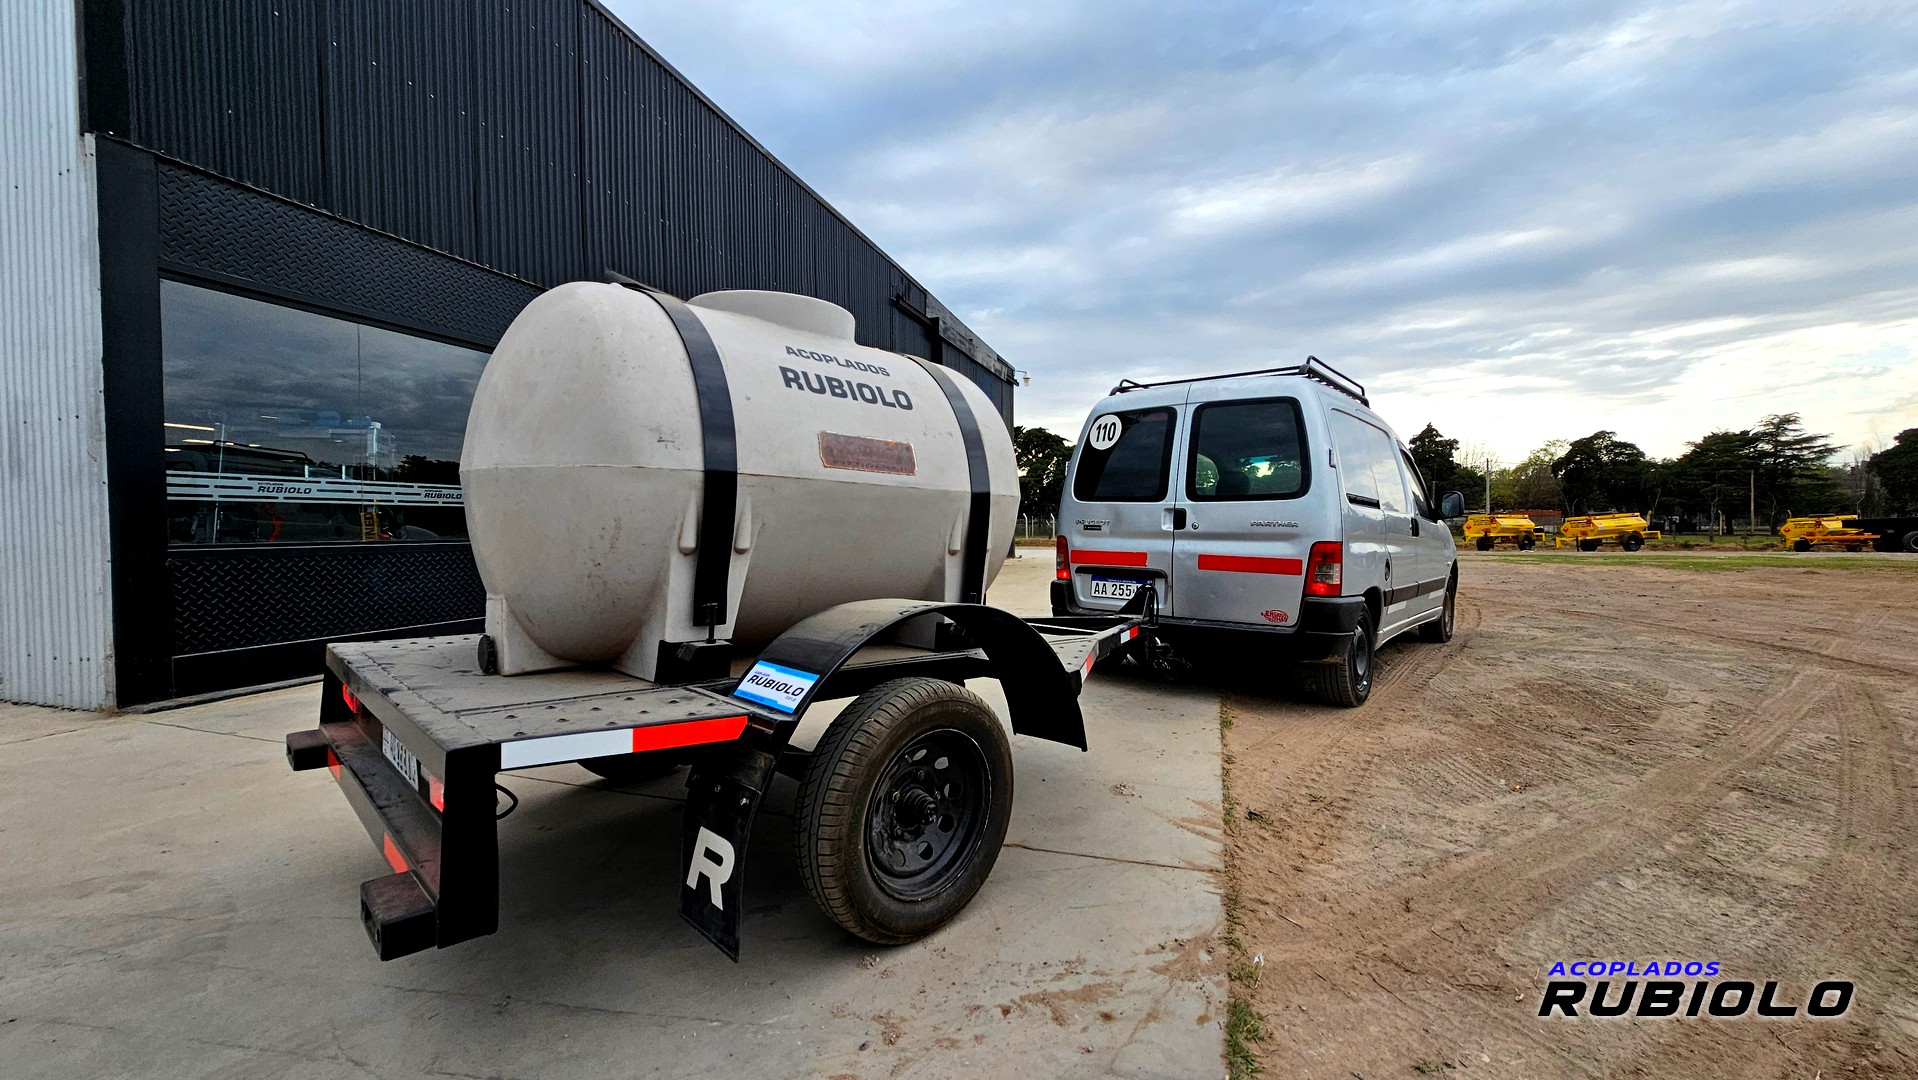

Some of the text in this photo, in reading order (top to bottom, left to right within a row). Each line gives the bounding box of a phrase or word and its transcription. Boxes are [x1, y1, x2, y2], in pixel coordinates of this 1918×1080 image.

[785, 345, 891, 377] ACOPLADOS
[778, 365, 914, 411] RUBIOLO
[1095, 421, 1117, 443] 110
[257, 485, 312, 495] RUBIOLO
[424, 492, 463, 500] RUBIOLO
[1251, 520, 1299, 528] PARTNER
[1094, 582, 1107, 596] AA
[1111, 583, 1132, 598] 255
[747, 674, 805, 697] RUBIOLO
[686, 826, 735, 911] R
